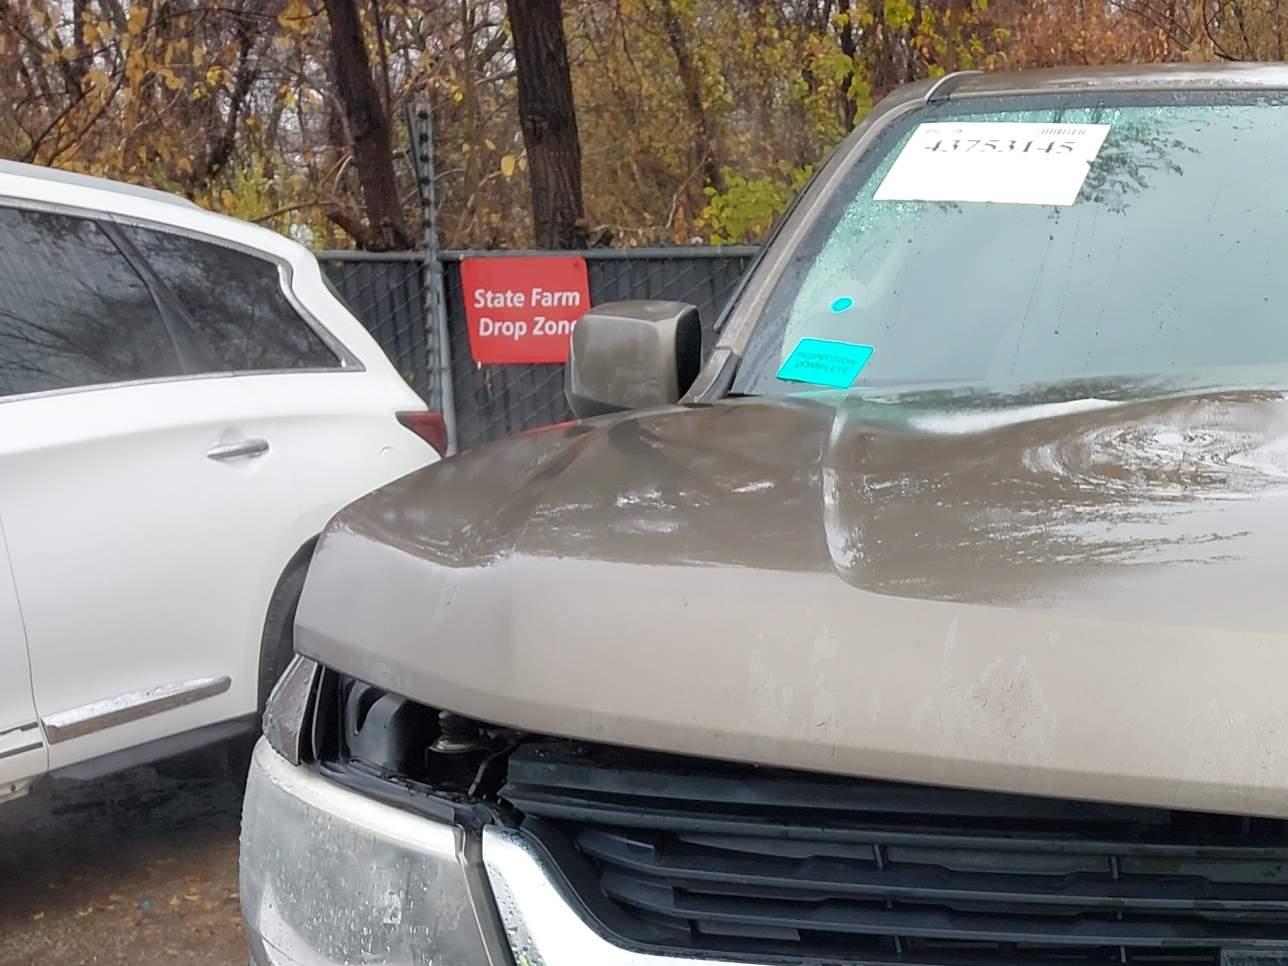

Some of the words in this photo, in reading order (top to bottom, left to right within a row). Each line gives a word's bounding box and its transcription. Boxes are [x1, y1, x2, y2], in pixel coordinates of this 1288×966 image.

[924, 139, 1077, 154] 43753145
[474, 288, 526, 309] State
[531, 287, 581, 307] Farm
[479, 317, 528, 341] Drop
